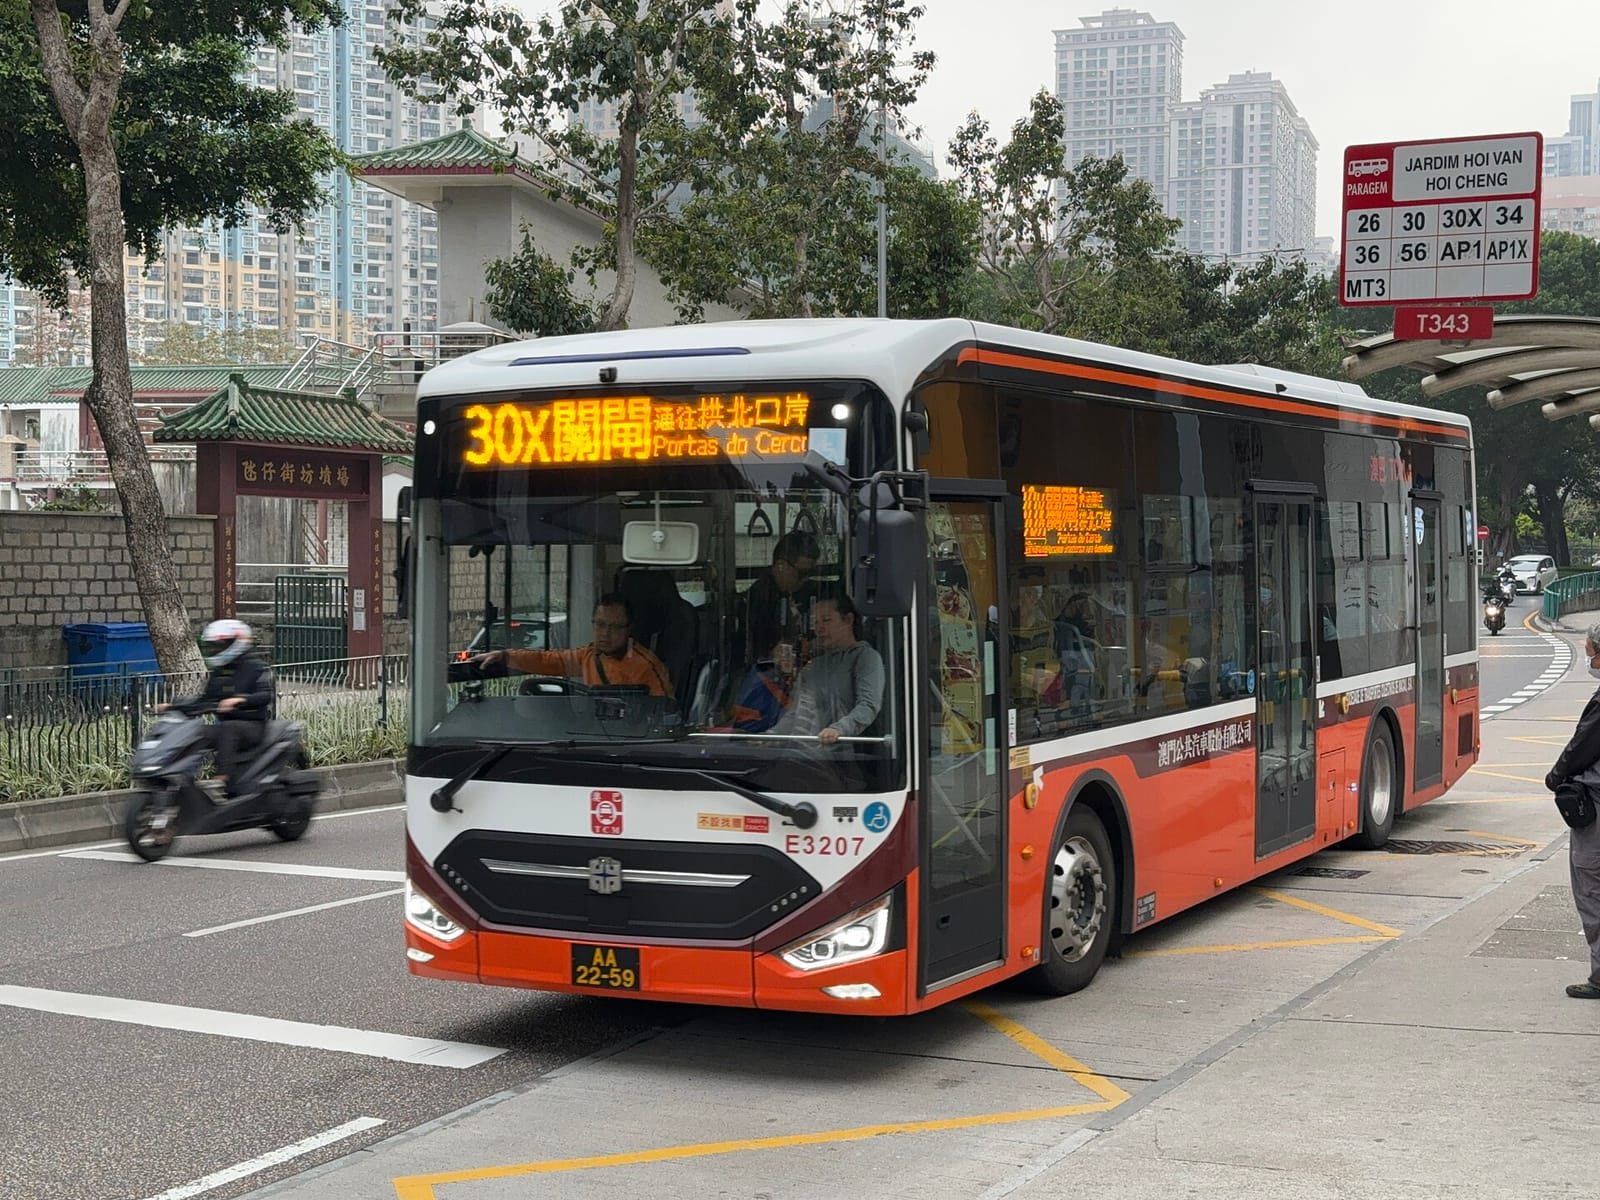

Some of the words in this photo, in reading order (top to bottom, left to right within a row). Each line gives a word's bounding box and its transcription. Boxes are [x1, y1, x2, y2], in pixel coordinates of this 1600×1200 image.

[1405, 154, 1459, 172] JARDIM
[1463, 152, 1489, 169] HOI
[1492, 150, 1523, 166] VAN
[1346, 181, 1388, 196] PARAGEM
[1426, 176, 1451, 192] HOI
[1455, 172, 1508, 190] CHENG
[1357, 213, 1380, 233] 26
[1402, 211, 1425, 231] 30
[1442, 207, 1483, 228] 30X
[1495, 205, 1524, 225] 34
[1355, 245, 1380, 264] 36
[1400, 242, 1427, 262] 56
[1440, 240, 1482, 261] AP1
[1486, 239, 1528, 260] AP1X
[1346, 278, 1386, 298] MT3
[1416, 313, 1470, 333] T343
[553, 397, 651, 462] 關閘
[653, 434, 719, 457] Portas
[725, 432, 749, 455] do
[1158, 719, 1252, 768] 澳門公共汽車股份有限公司
[785, 834, 865, 856] E3207
[592, 946, 618, 967] AA
[576, 964, 636, 988] 22-59
